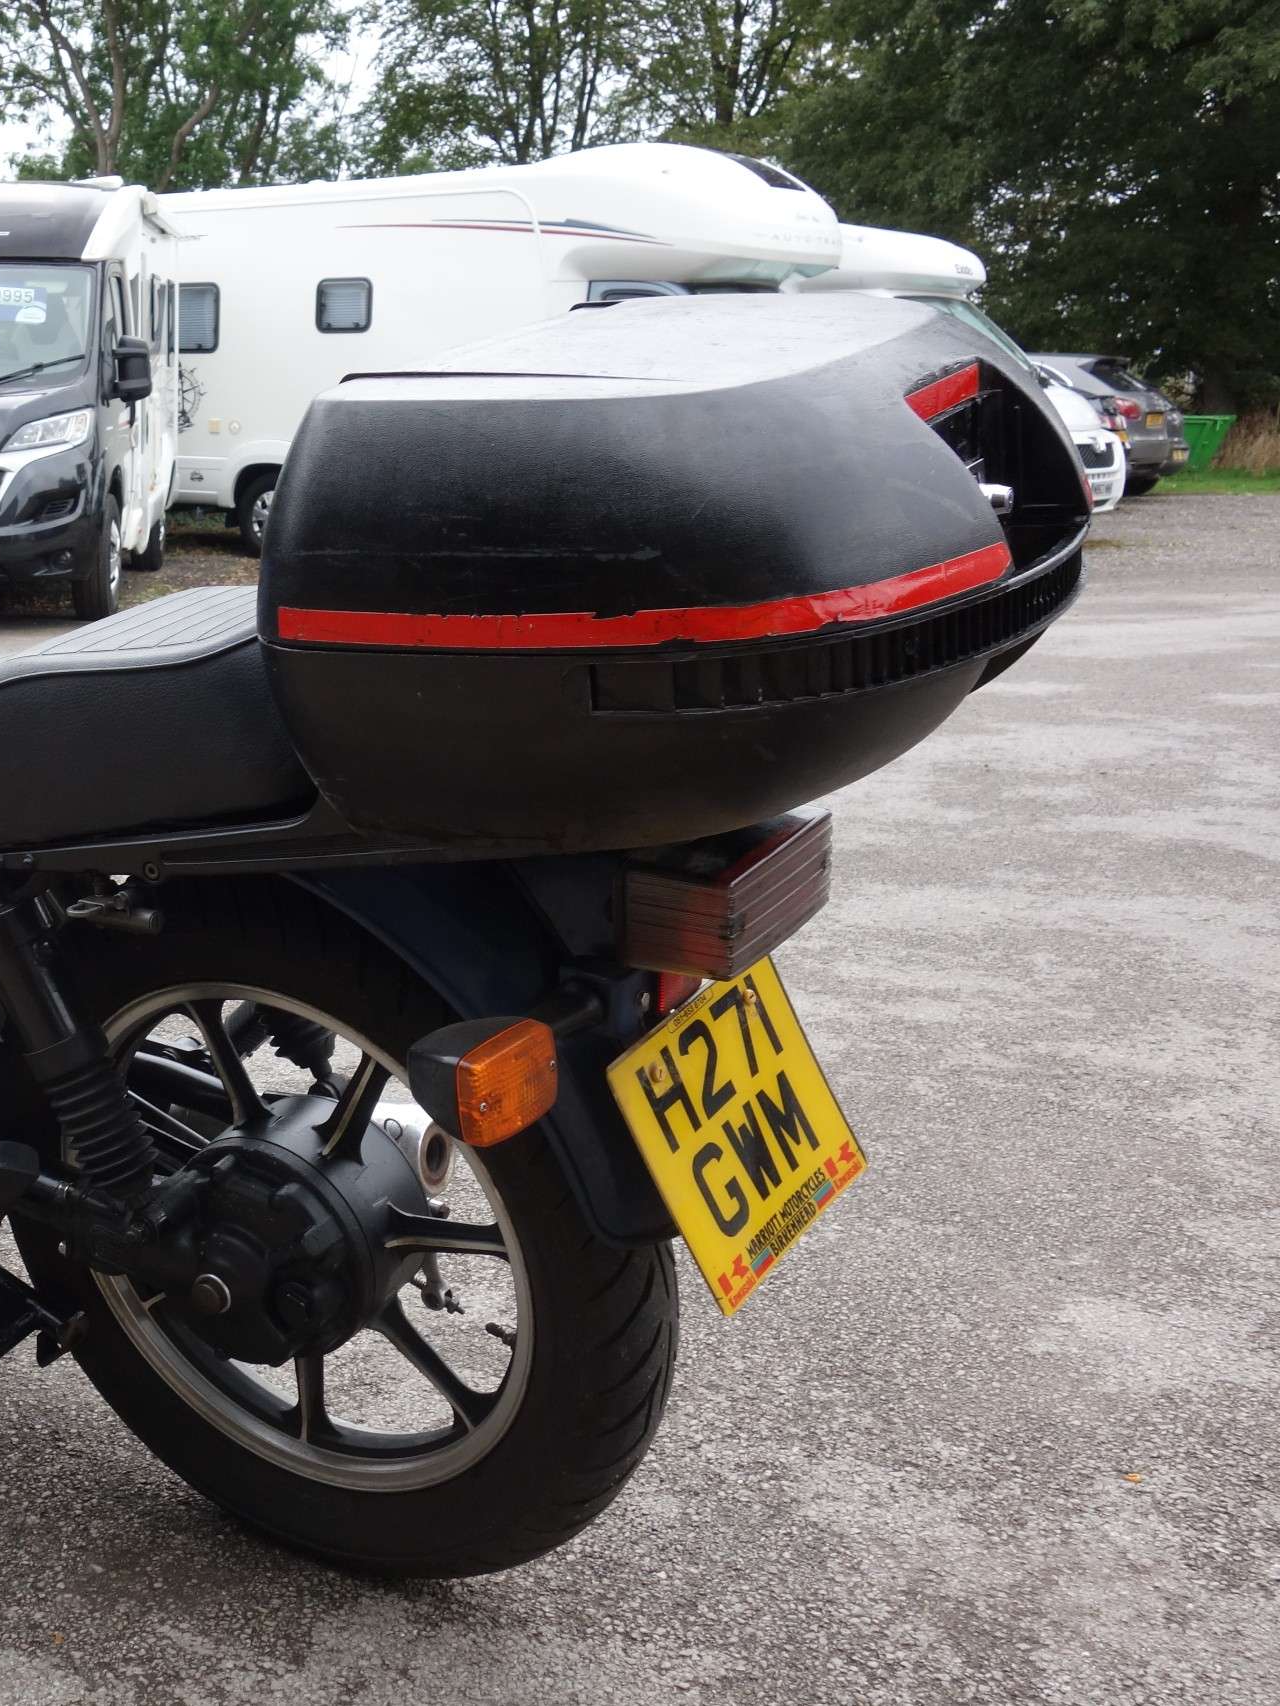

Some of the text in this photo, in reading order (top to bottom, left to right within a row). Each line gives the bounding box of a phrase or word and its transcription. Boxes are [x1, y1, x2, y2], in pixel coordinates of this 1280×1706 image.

[634, 973, 784, 1154] H271
[691, 1070, 821, 1238] GWM
[745, 1166, 826, 1259] MARRIOTT MOTORCYCLES
[770, 1202, 817, 1259] BIRKENHEAD
